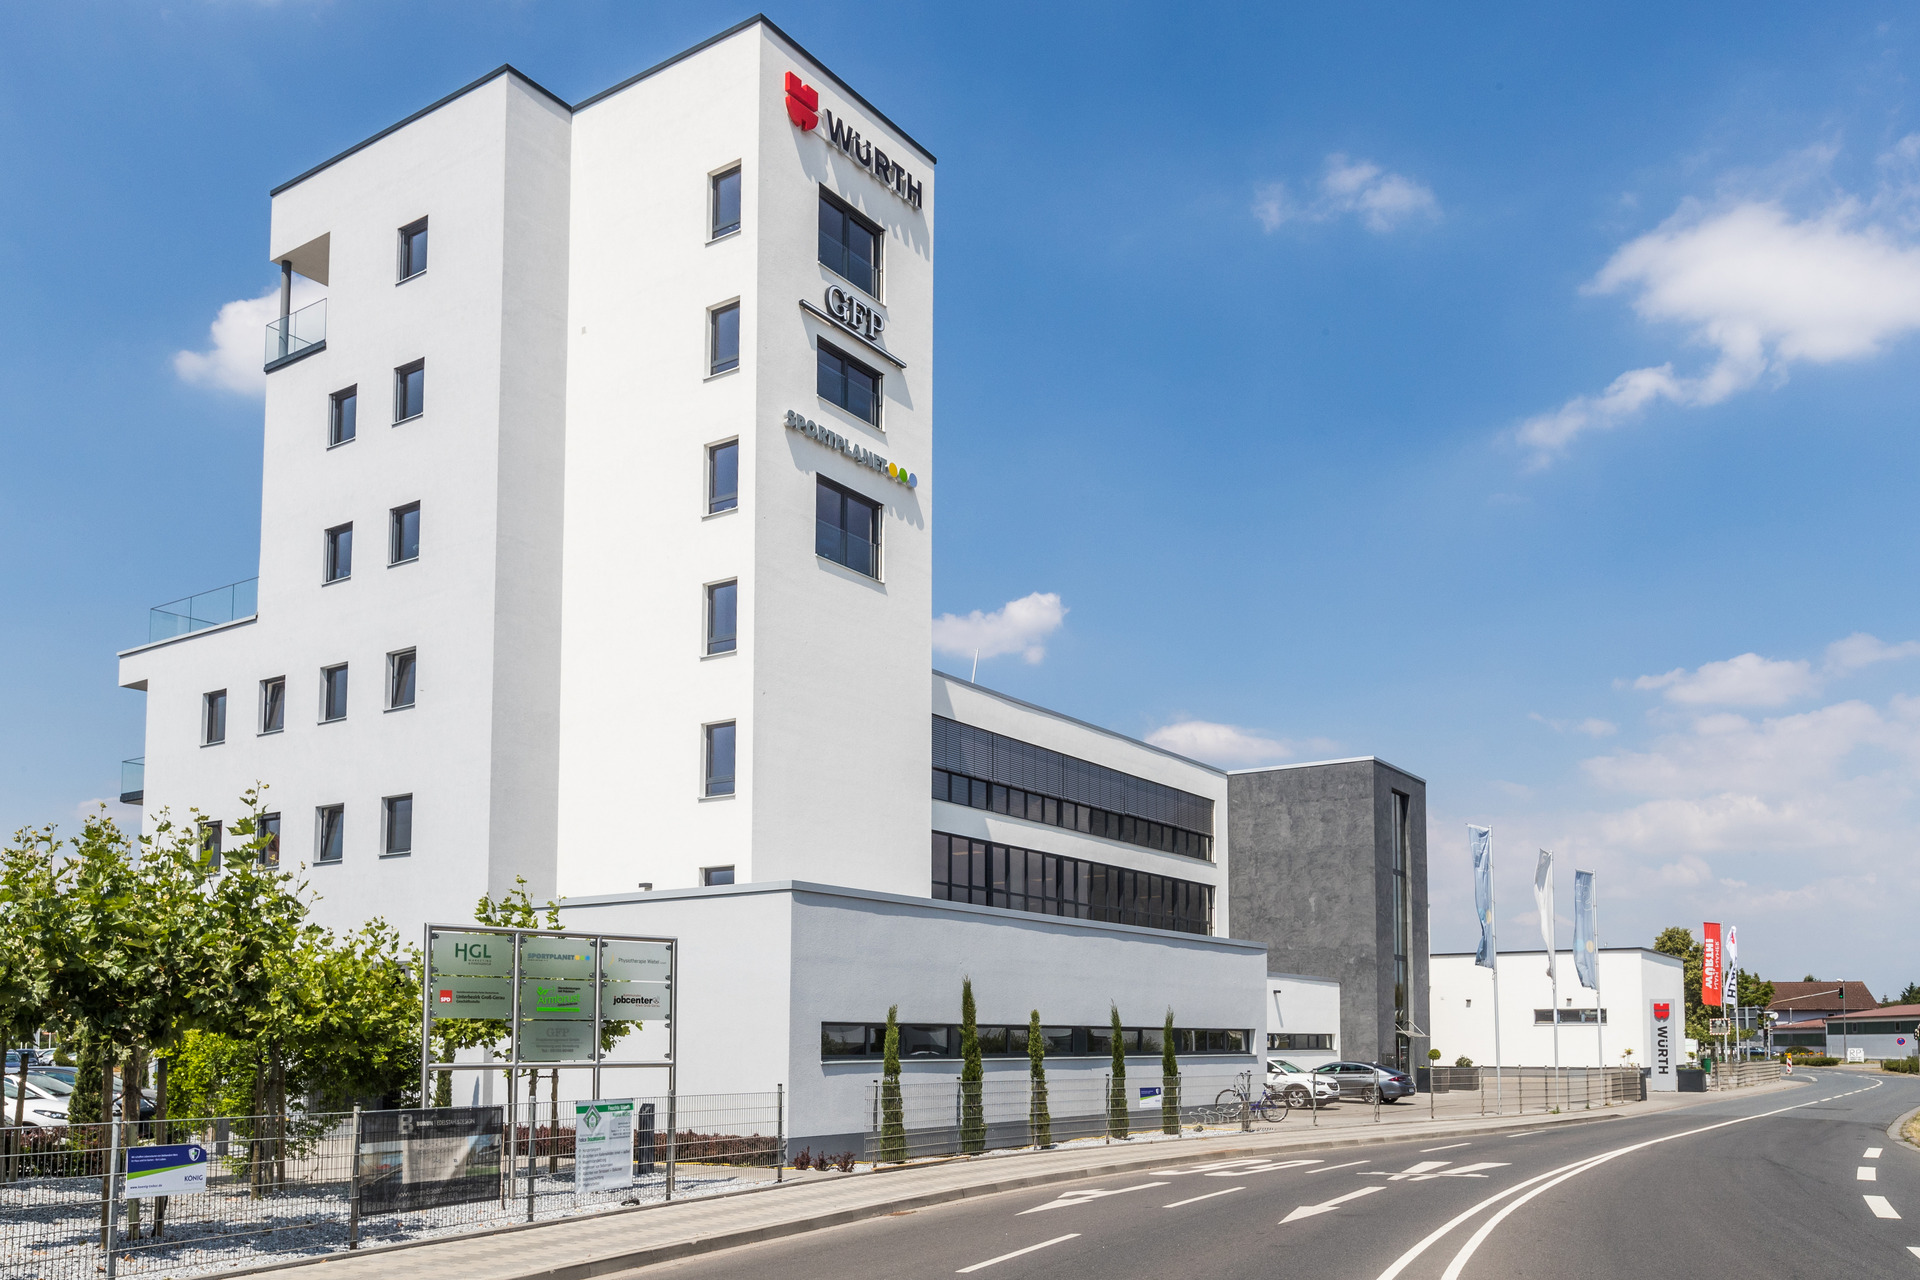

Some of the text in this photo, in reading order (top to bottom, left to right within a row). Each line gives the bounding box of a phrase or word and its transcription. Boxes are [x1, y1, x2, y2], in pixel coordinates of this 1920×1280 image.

[824, 109, 922, 209] WÜRTH
[825, 285, 885, 340] GFP
[785, 409, 888, 473] SPORTPLANET
[455, 943, 492, 961] HGL
[528, 952, 575, 961] SPORTPLANET
[536, 993, 580, 1006] Armbrust
[613, 995, 653, 1006] jobcenter
[546, 1027, 569, 1038] GFP
[1657, 1025, 1669, 1075] WÜRTH
[184, 1174, 204, 1182] KÖNIG
